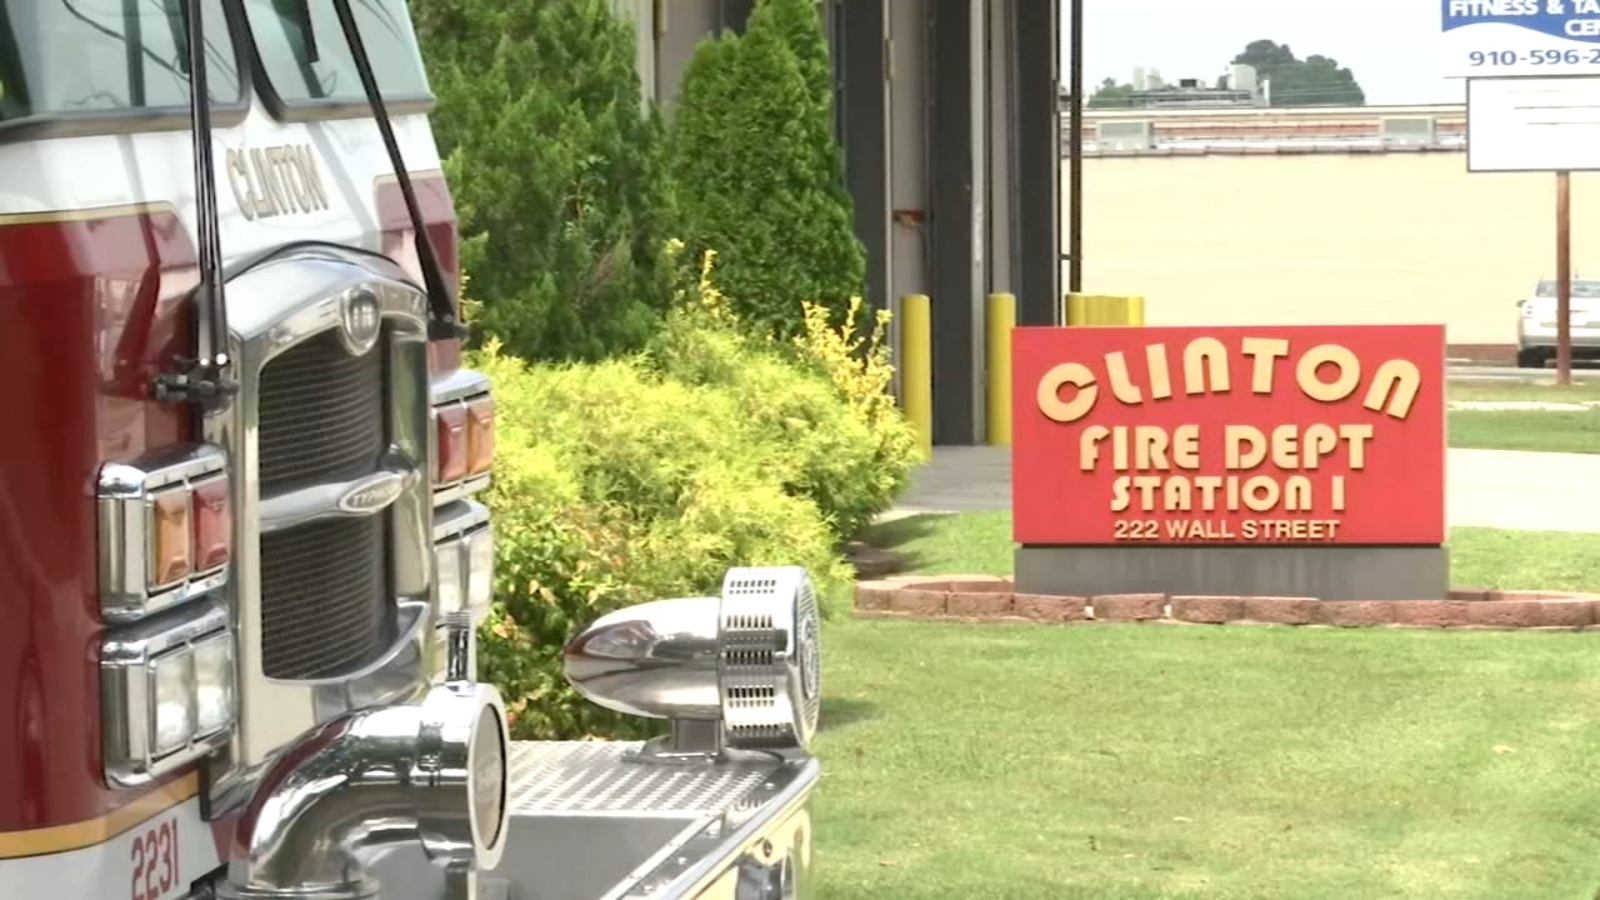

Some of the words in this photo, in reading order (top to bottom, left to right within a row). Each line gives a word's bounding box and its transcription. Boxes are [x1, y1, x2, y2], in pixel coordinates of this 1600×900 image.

[1450, 0, 1539, 16] FITNESS
[1546, 0, 1565, 14] &
[226, 143, 329, 221] CLINTON
[1037, 337, 1421, 422] CLINTON
[1080, 425, 1200, 470] FIRE
[1225, 423, 1374, 469] DEPT
[1111, 475, 1312, 511] STATION
[1114, 519, 1159, 538] 222
[1165, 519, 1235, 538] WALL
[1241, 519, 1340, 538] STREET
[131, 817, 179, 900] 2231
